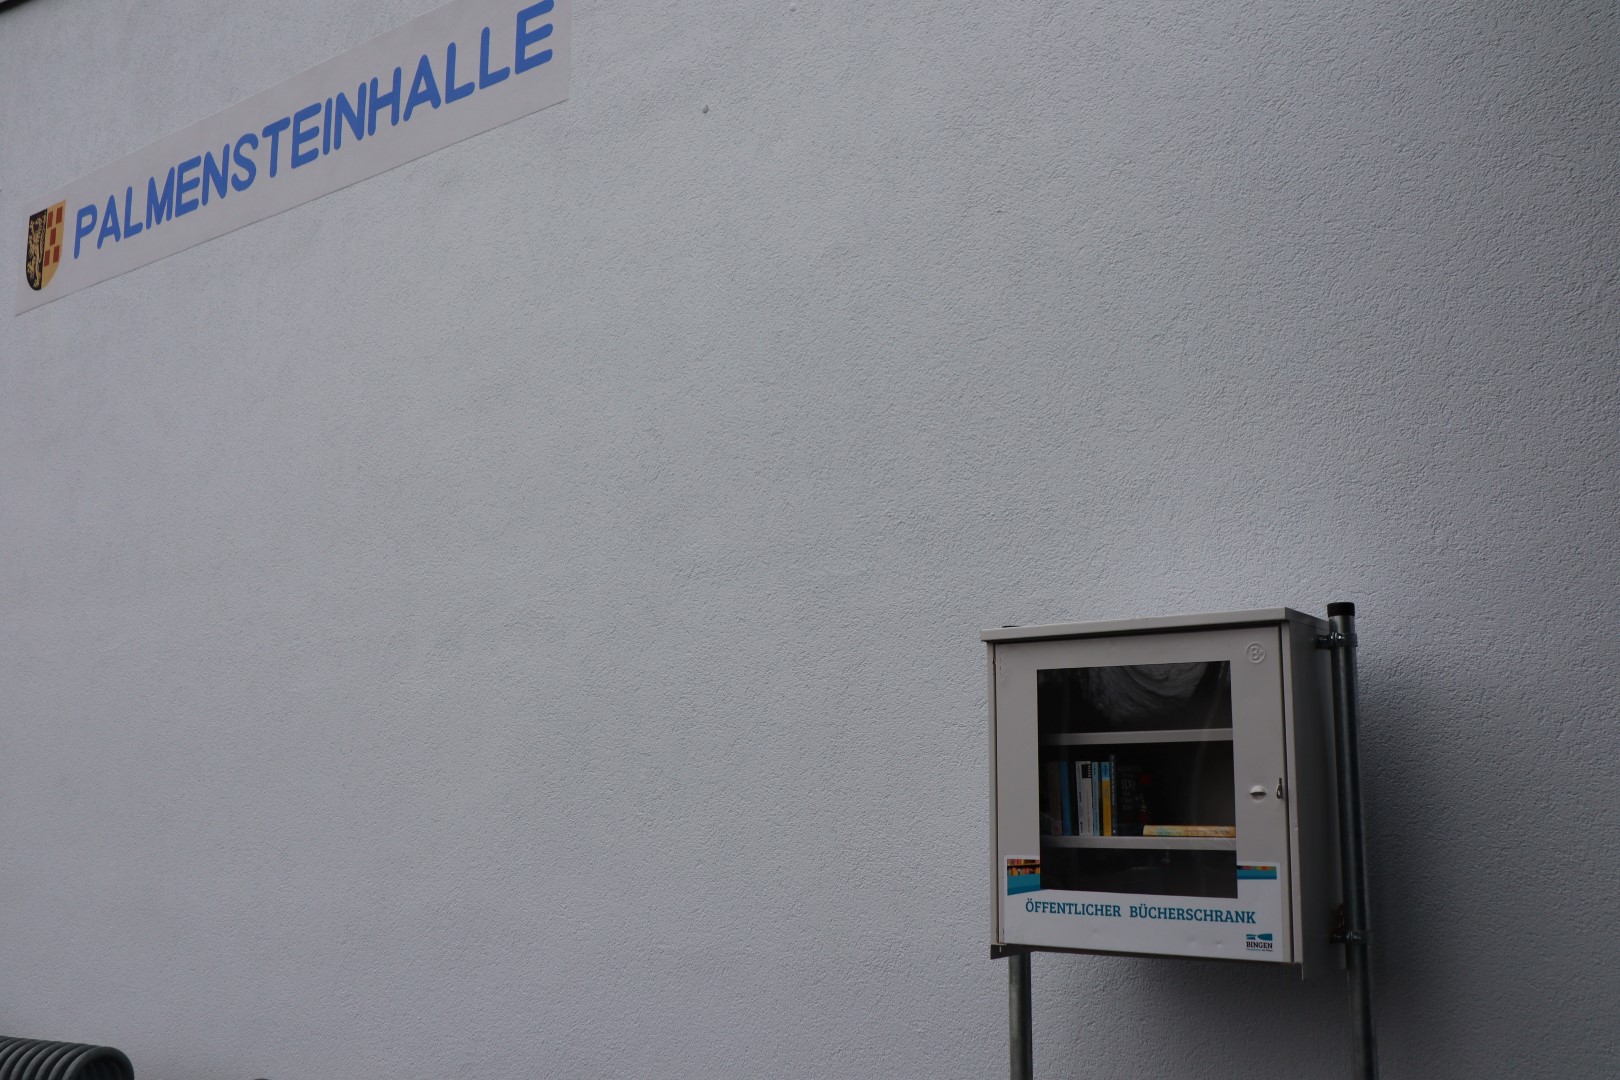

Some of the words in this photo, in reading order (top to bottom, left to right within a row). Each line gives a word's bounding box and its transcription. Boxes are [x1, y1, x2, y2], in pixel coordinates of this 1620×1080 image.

[74, 0, 555, 259] PALMENSTEINHALLE
[1025, 898, 1122, 918] ÖFFENTLICHER
[1130, 905, 1256, 924] BÜCHERSCHRANK
[1246, 941, 1273, 949] BINGEN
